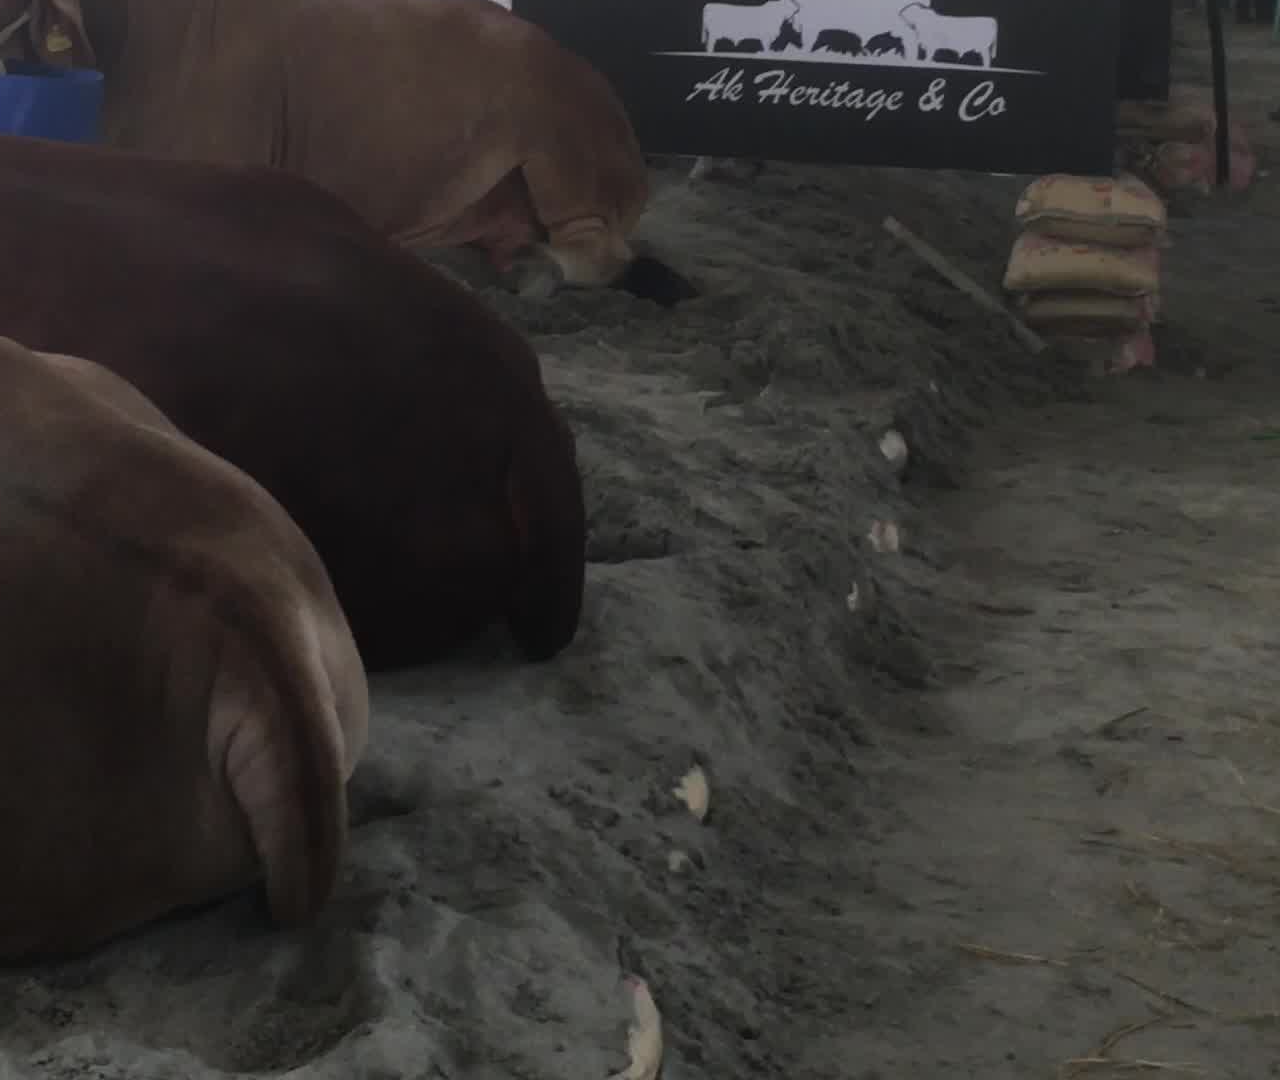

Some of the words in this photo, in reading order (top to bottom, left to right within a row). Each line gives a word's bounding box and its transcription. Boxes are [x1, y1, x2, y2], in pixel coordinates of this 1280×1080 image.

[685, 67, 745, 102] Ak
[753, 69, 904, 122] Heritage
[919, 77, 947, 112] &
[958, 80, 1008, 122] Co
